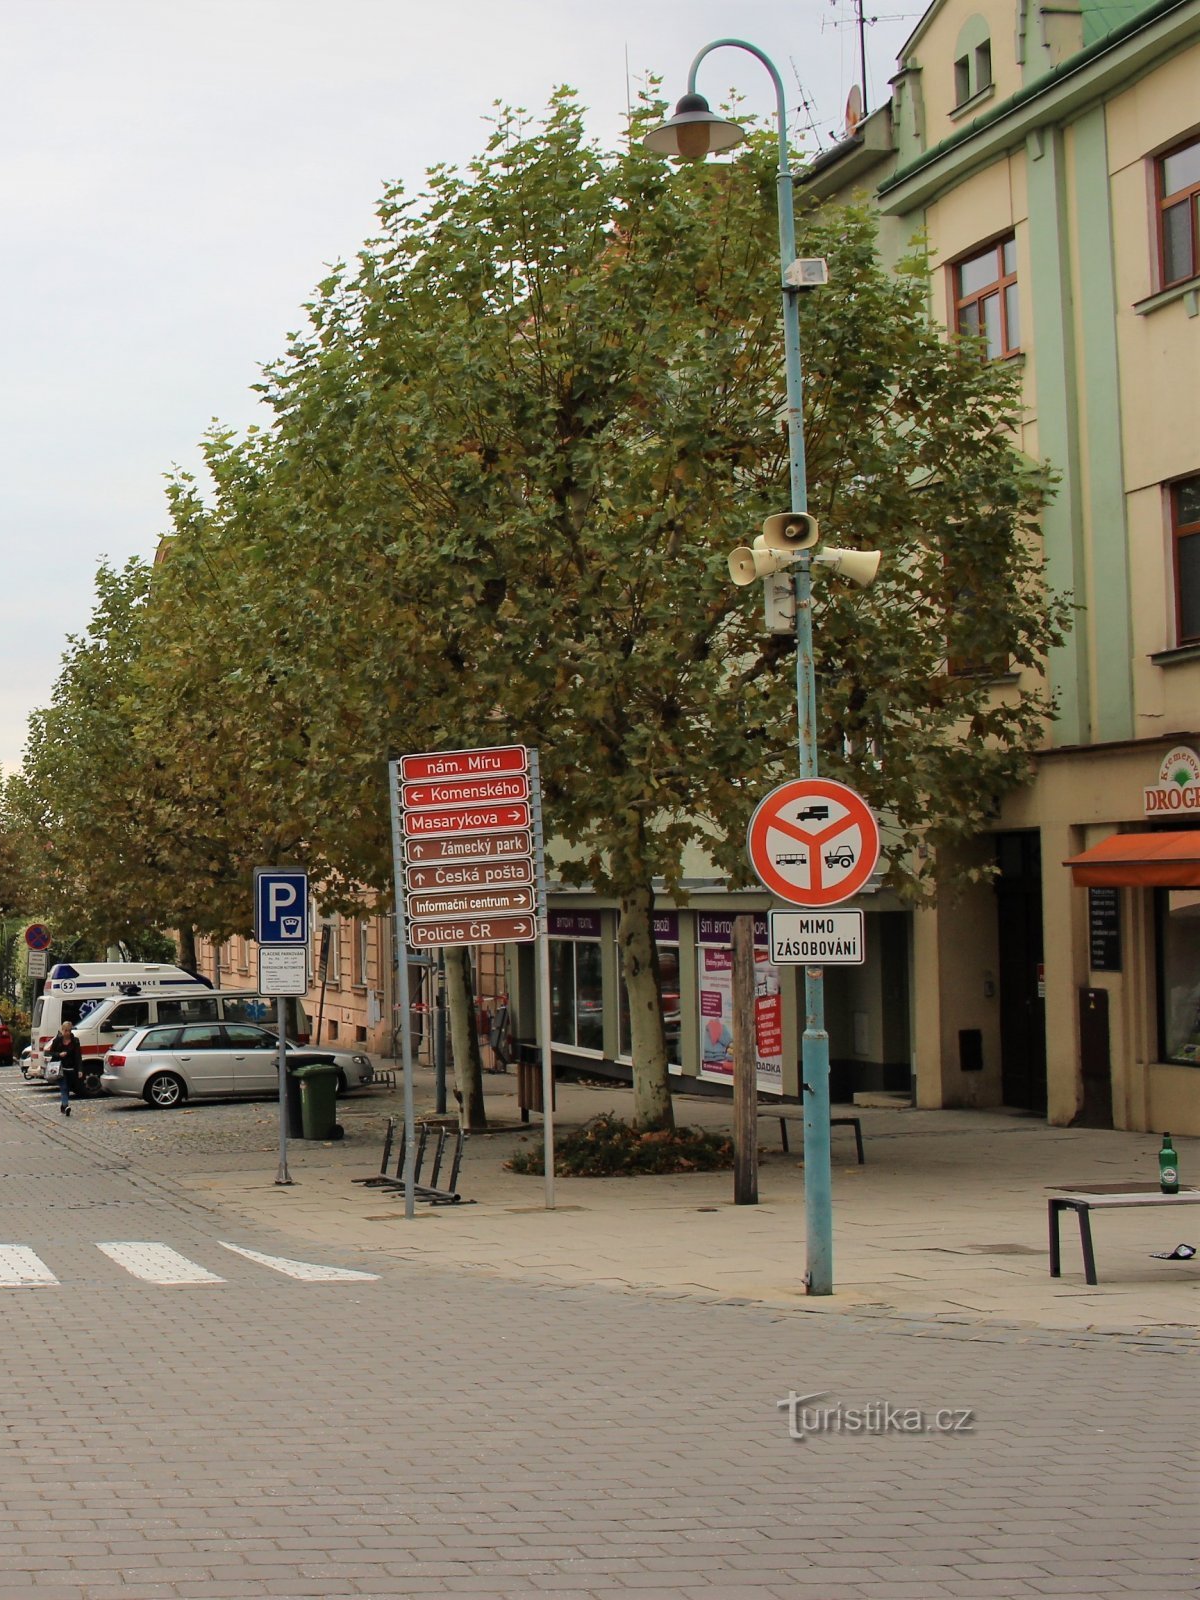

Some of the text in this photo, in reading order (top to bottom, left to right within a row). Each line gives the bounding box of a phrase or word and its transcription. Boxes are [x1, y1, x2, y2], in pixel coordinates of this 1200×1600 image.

[427, 756, 501, 774] nám. Míru
[1161, 752, 1199, 780] Kremerova
[431, 782, 520, 800] Komenského
[412, 813, 498, 829] Masarykova
[440, 838, 522, 855] Zámecký park
[435, 865, 525, 883] Česká pošta
[269, 882, 297, 921] P
[416, 896, 509, 912] Informační centrum
[417, 921, 491, 941] Policie ČR
[800, 919, 834, 933] MIMO
[777, 937, 856, 956] ZÁSOBOVÁNÍ
